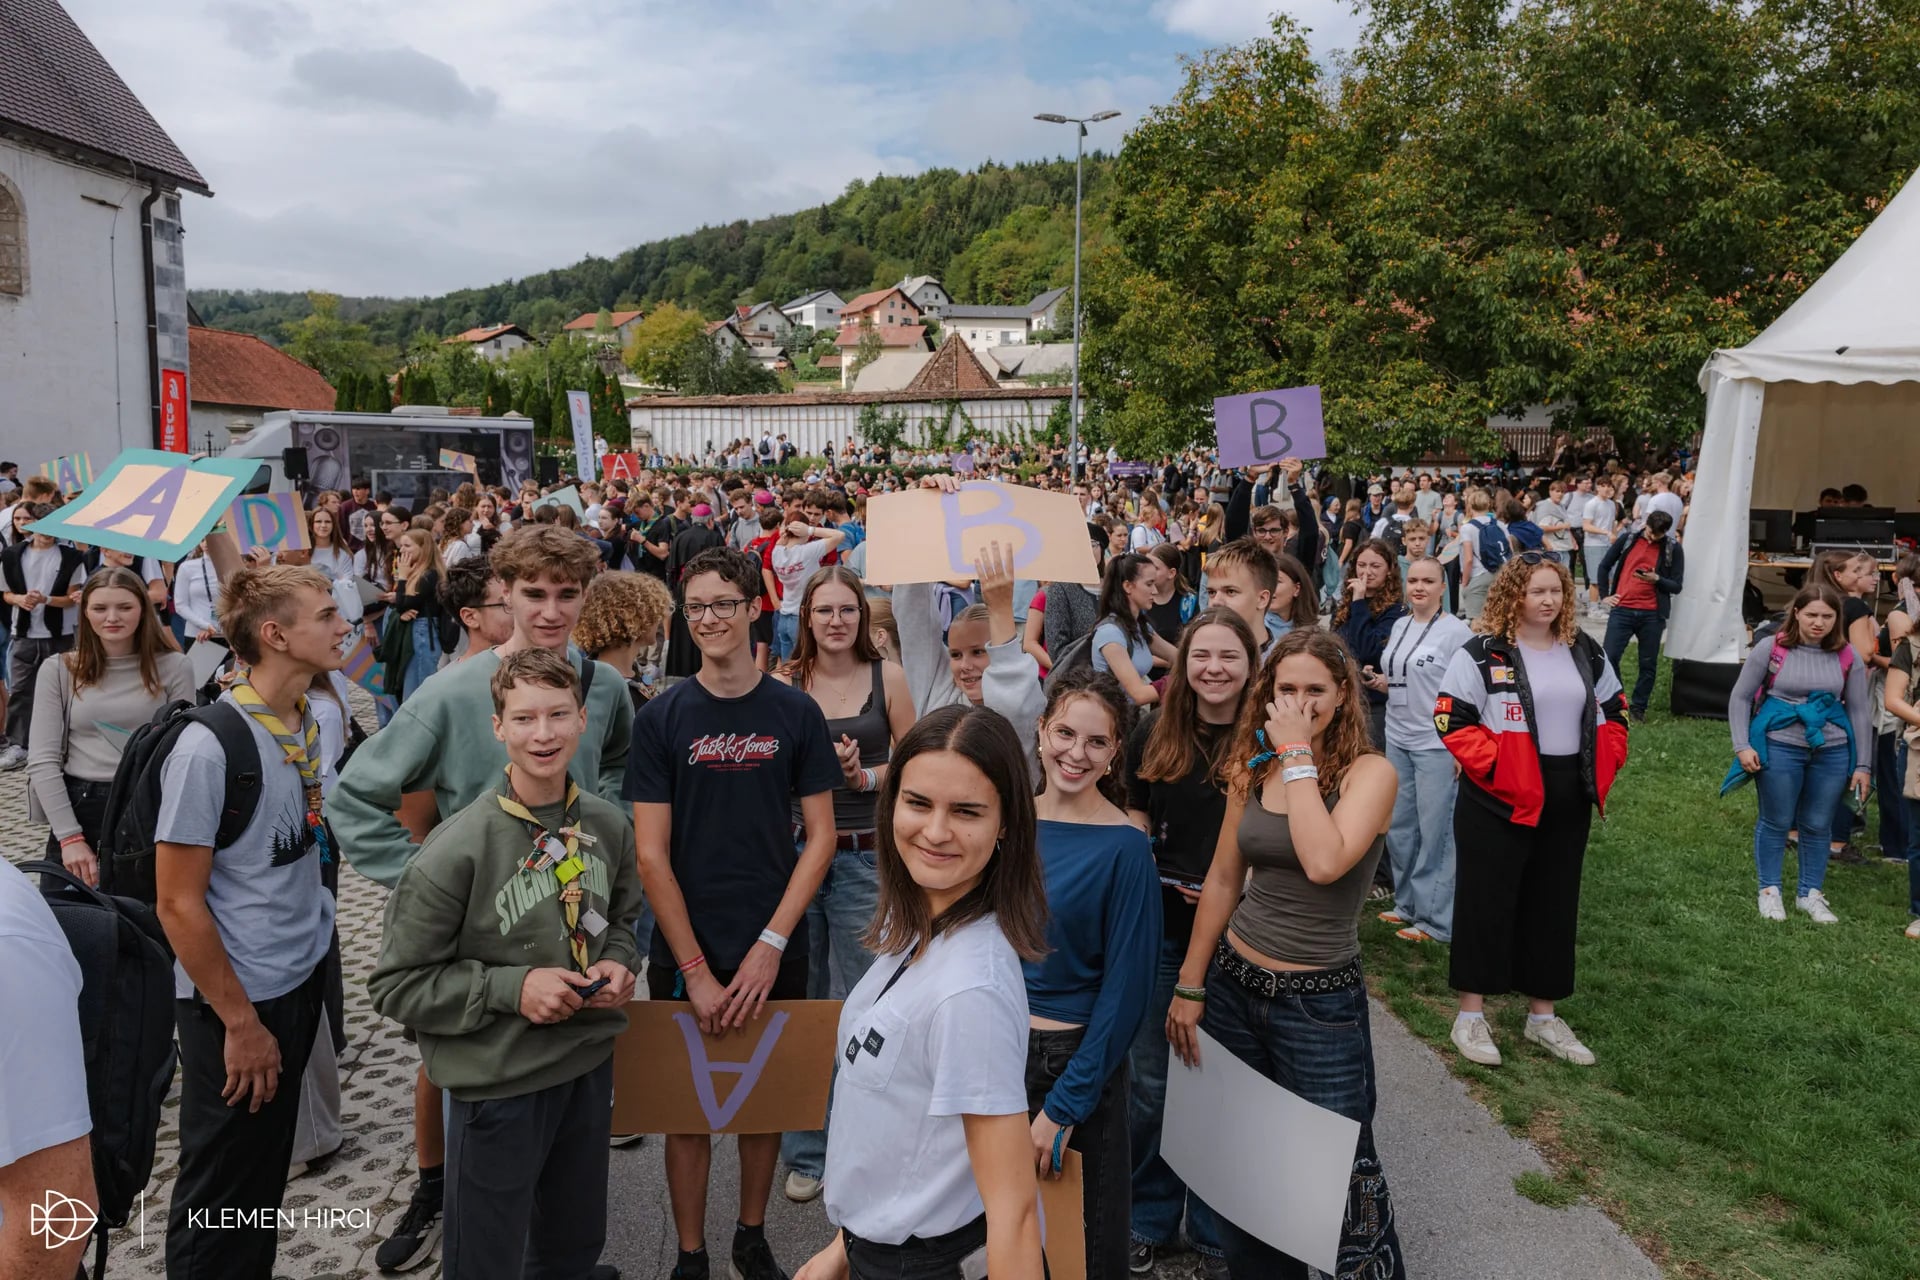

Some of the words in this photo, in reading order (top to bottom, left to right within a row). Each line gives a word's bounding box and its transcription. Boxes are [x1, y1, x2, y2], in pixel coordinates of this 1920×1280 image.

[1250, 398, 1292, 460] B
[58, 456, 82, 495] A
[452, 454, 466, 471] A
[612, 454, 632, 480] A
[93, 463, 188, 541] A
[241, 497, 288, 548] D
[941, 480, 1043, 574] B
[735, 733, 779, 763] Jones
[672, 1010, 790, 1131] A
